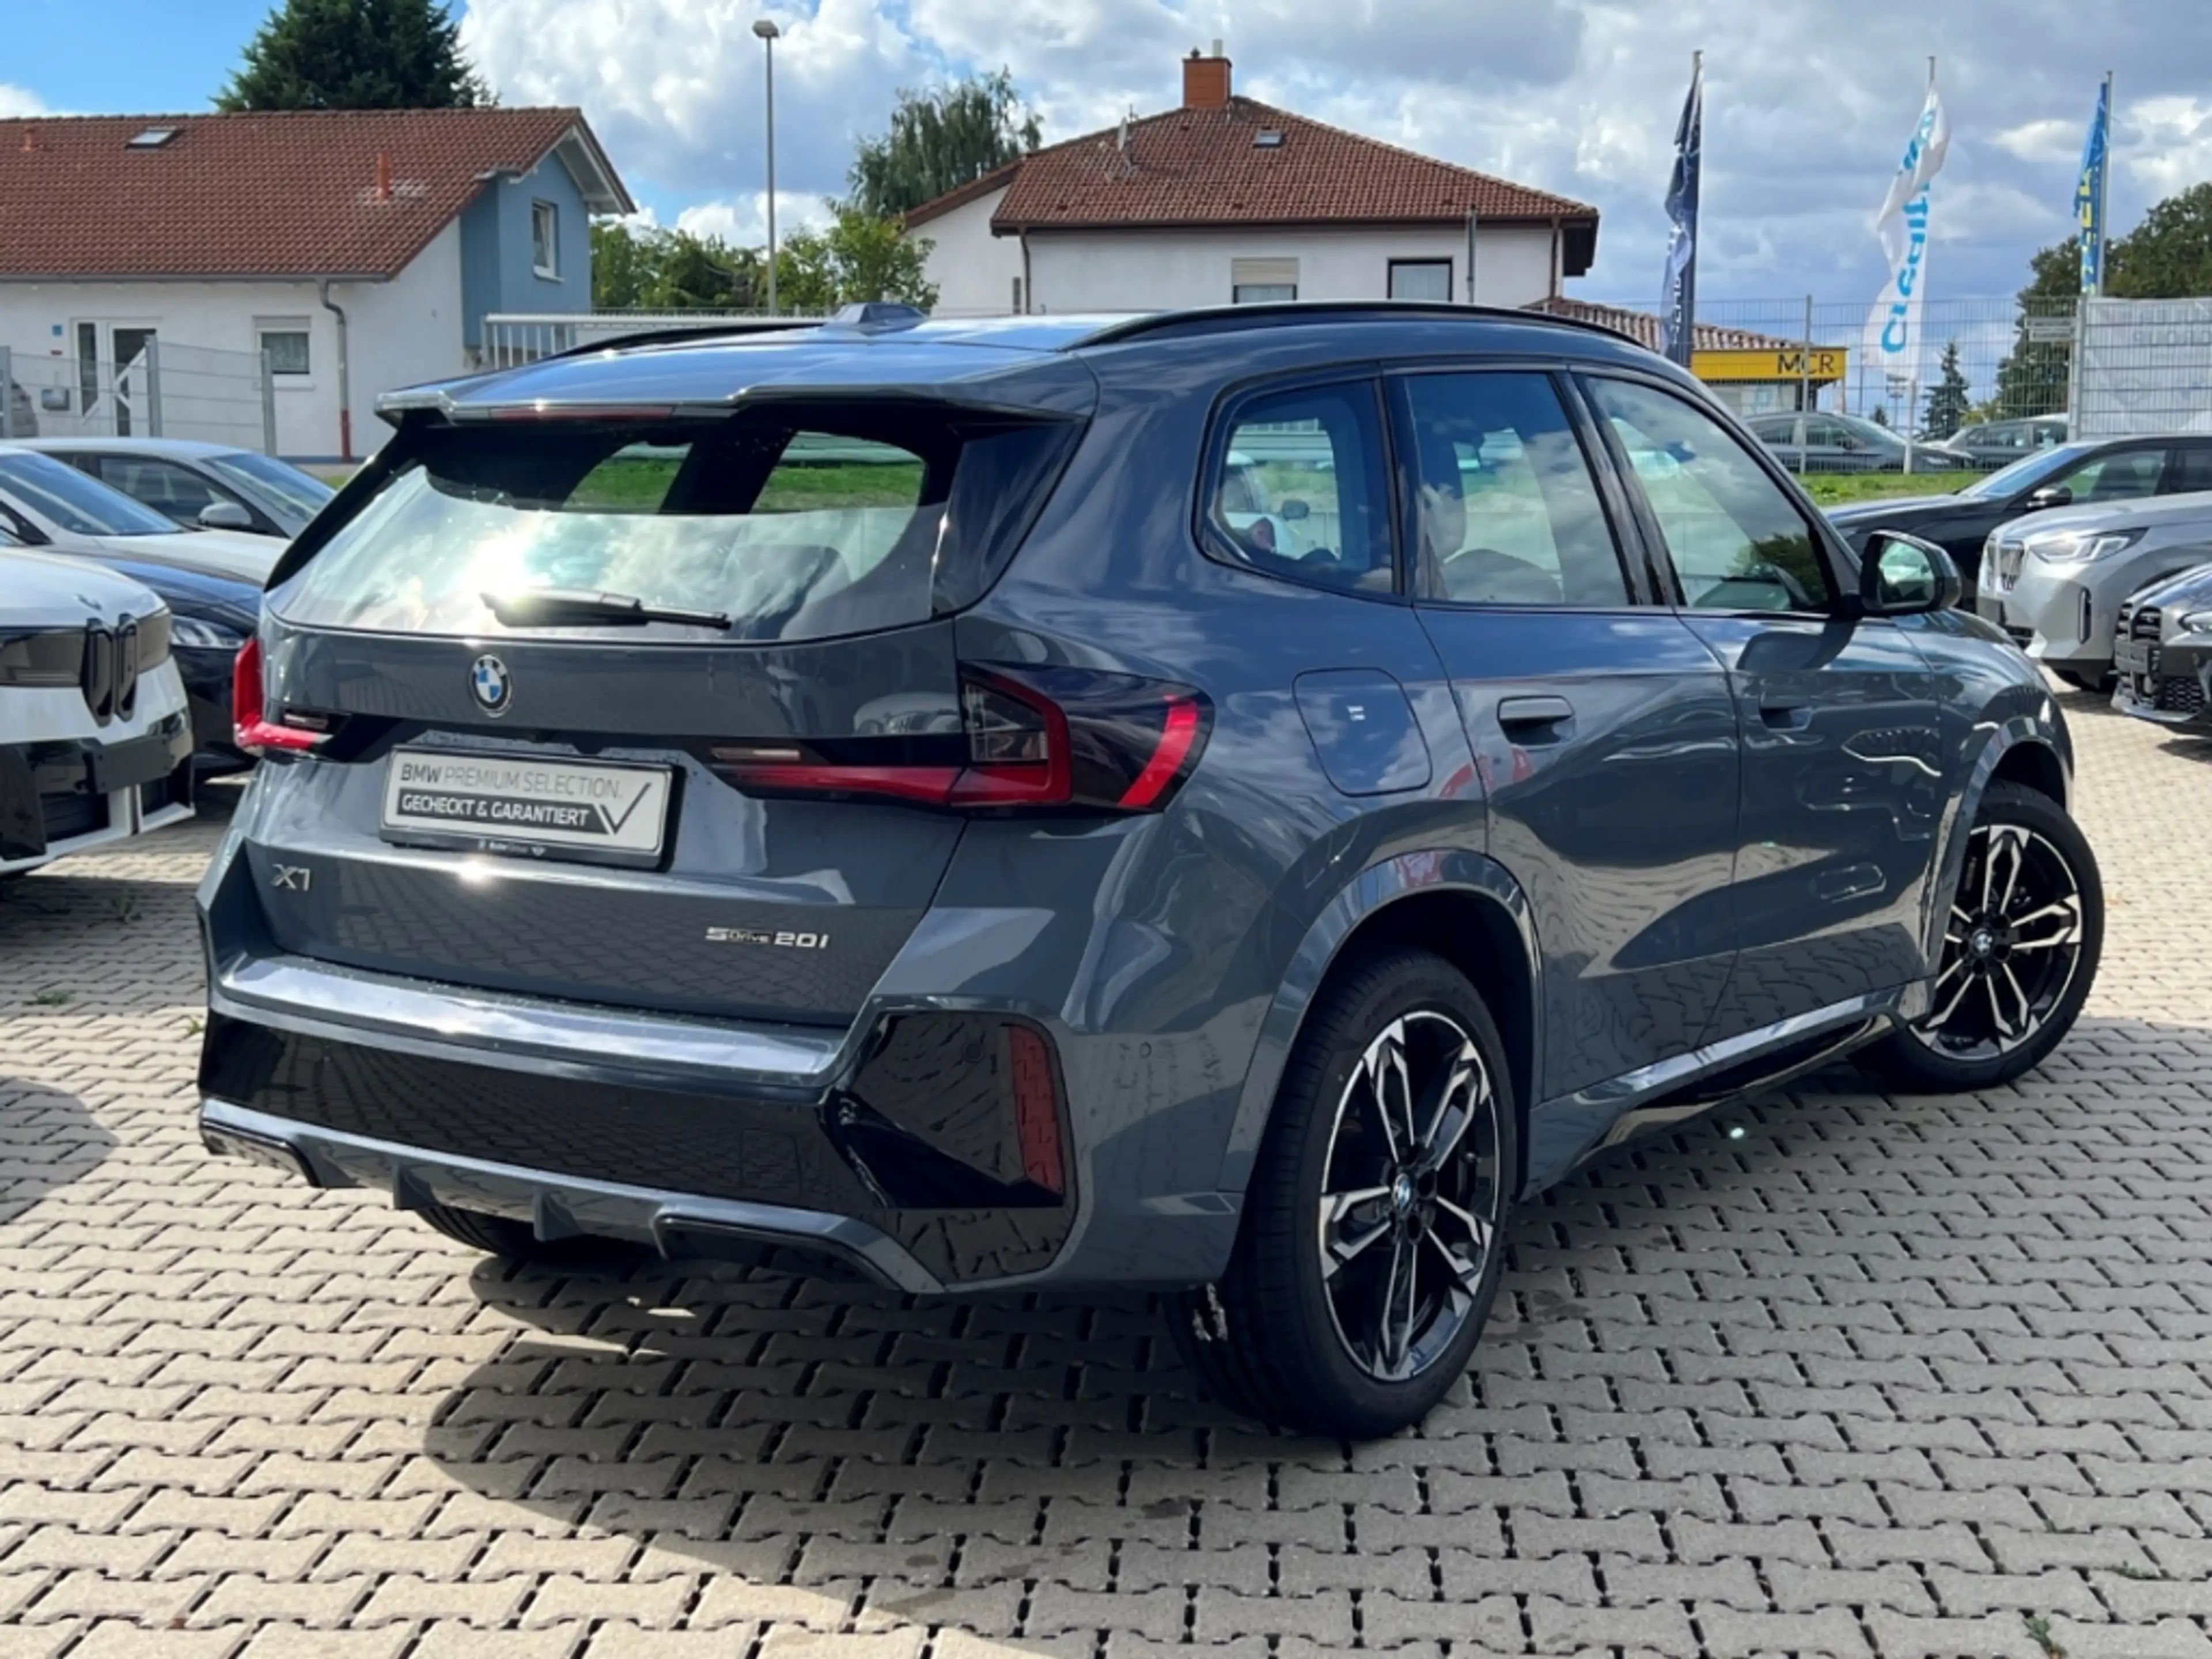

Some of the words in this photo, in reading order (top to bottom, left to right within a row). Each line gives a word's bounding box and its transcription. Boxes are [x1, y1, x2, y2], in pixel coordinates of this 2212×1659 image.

[1777, 353, 1835, 374] MCR
[402, 763, 442, 783] BMW
[444, 765, 520, 790] PREMIUM
[403, 793, 476, 816] GECHECKT
[476, 800, 488, 817] &
[491, 801, 590, 827] GARANTIERT
[270, 863, 310, 891] X1
